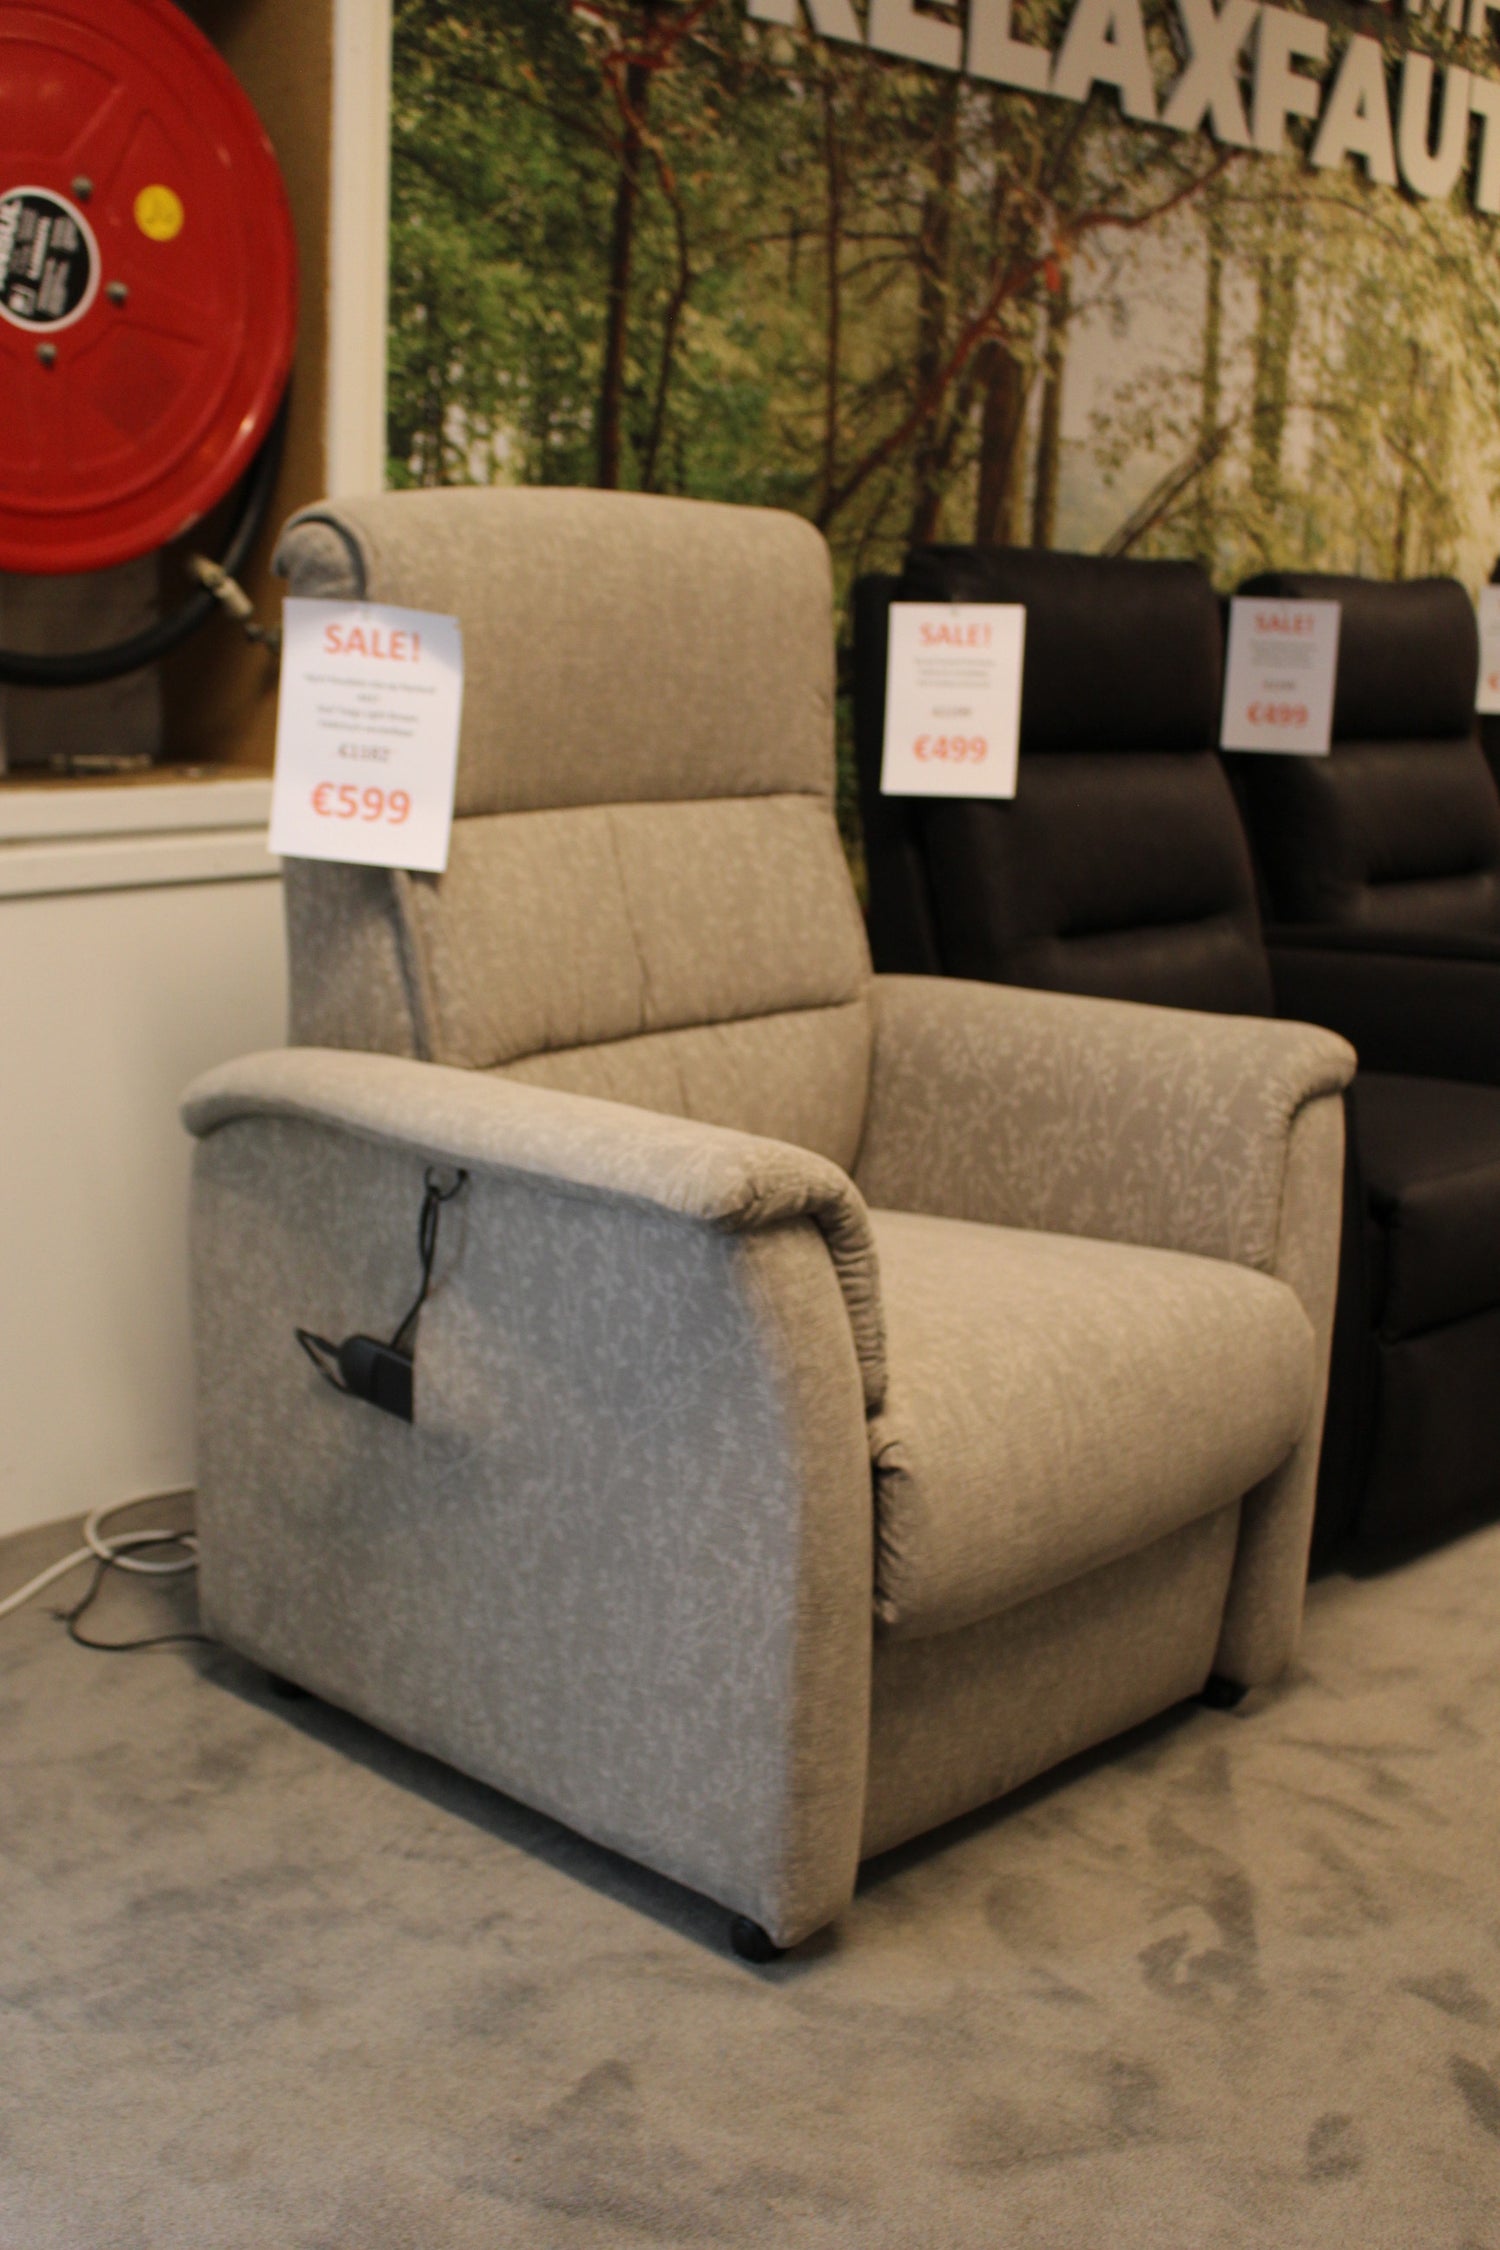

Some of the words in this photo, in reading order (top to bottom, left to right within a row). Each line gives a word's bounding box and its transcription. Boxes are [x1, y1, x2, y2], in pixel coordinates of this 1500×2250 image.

[746, 0, 1500, 214] LAXFAUT
[919, 622, 992, 647] SALE!
[1255, 612, 1315, 634] SALE!
[323, 624, 422, 663] SALE!
[1246, 702, 1309, 727] €499
[913, 734, 989, 764] €499
[311, 781, 411, 825] €599
